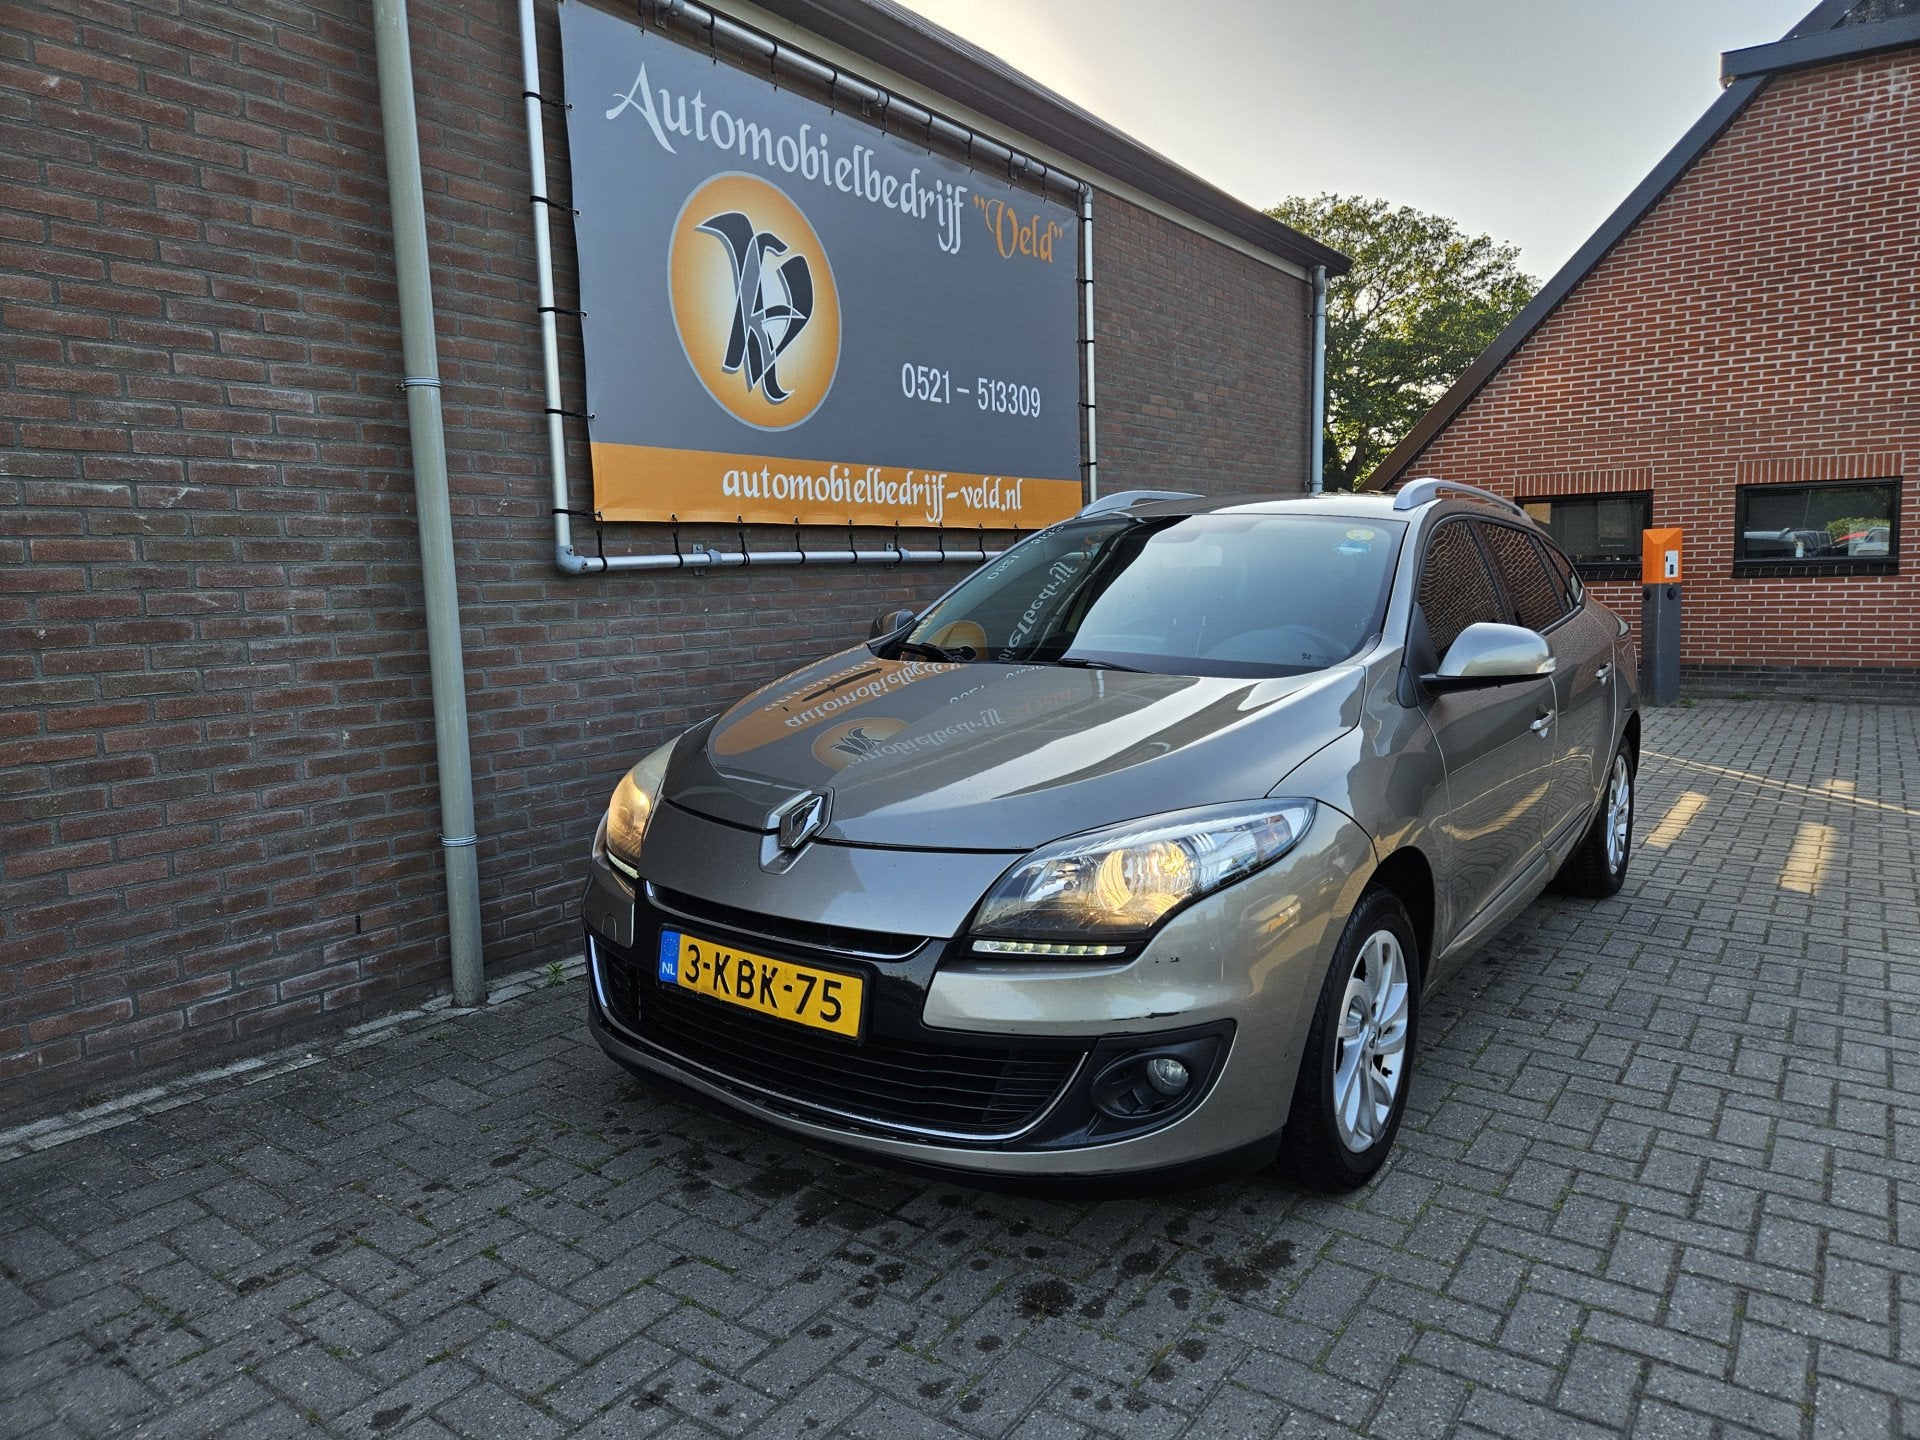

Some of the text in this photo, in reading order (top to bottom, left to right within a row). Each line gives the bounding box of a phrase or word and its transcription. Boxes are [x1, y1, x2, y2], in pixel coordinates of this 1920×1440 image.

[605, 61, 968, 254] Automobielbedrijf
[901, 362, 950, 404] 0521
[977, 377, 1041, 418] 513309
[722, 464, 1024, 524] automobielbedrijf-veld.nl
[661, 961, 676, 977] NL
[685, 943, 842, 1023] 3-KBK-75
